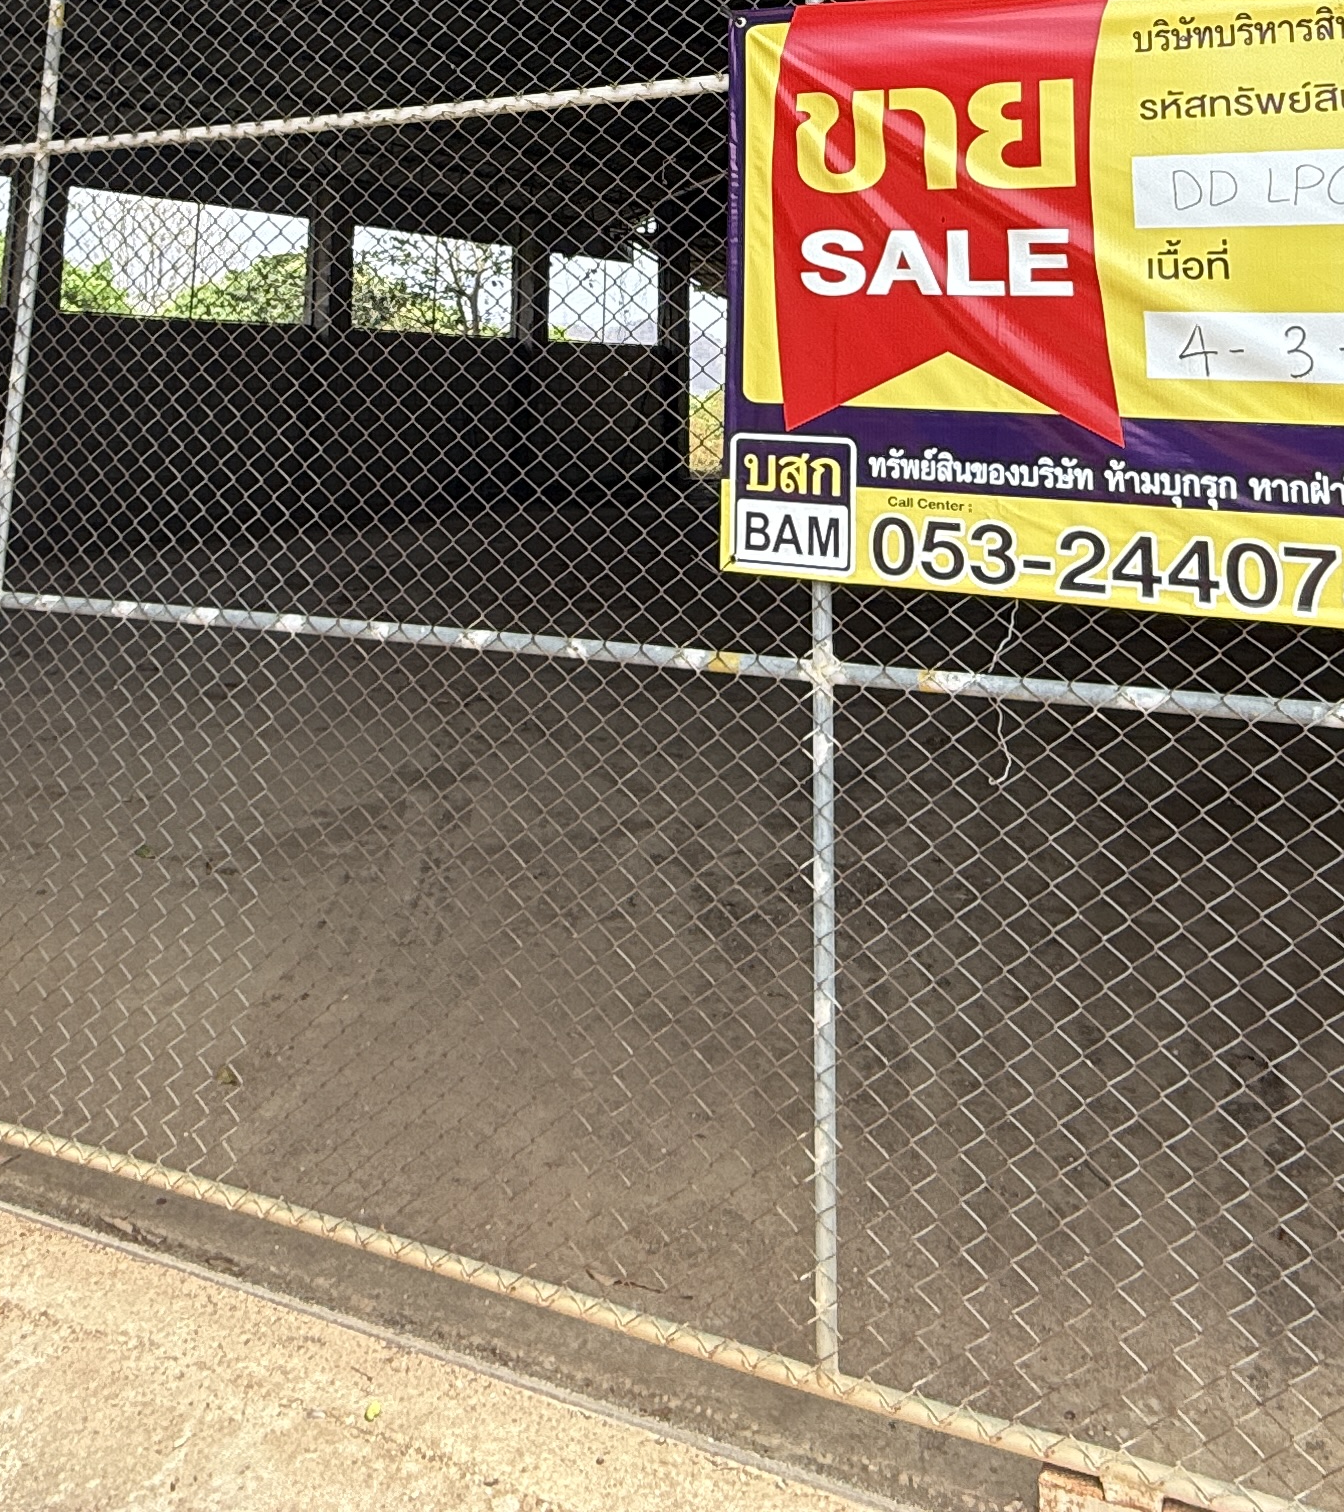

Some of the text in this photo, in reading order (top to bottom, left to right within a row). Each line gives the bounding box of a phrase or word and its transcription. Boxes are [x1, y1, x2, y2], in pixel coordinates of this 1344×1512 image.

[795, 77, 1077, 194] ขาย
[1171, 168, 1238, 211] DD
[800, 227, 1075, 298] SALE
[1146, 239, 1231, 283] เนื้อที่
[743, 451, 842, 498] บสก
[867, 447, 1095, 492] ทรัพย์สินของบริษัท
[1104, 462, 1238, 510] ห้ามบุกรุก
[887, 495, 914, 509] Call
[917, 498, 965, 513] Center
[743, 510, 841, 559] BAM
